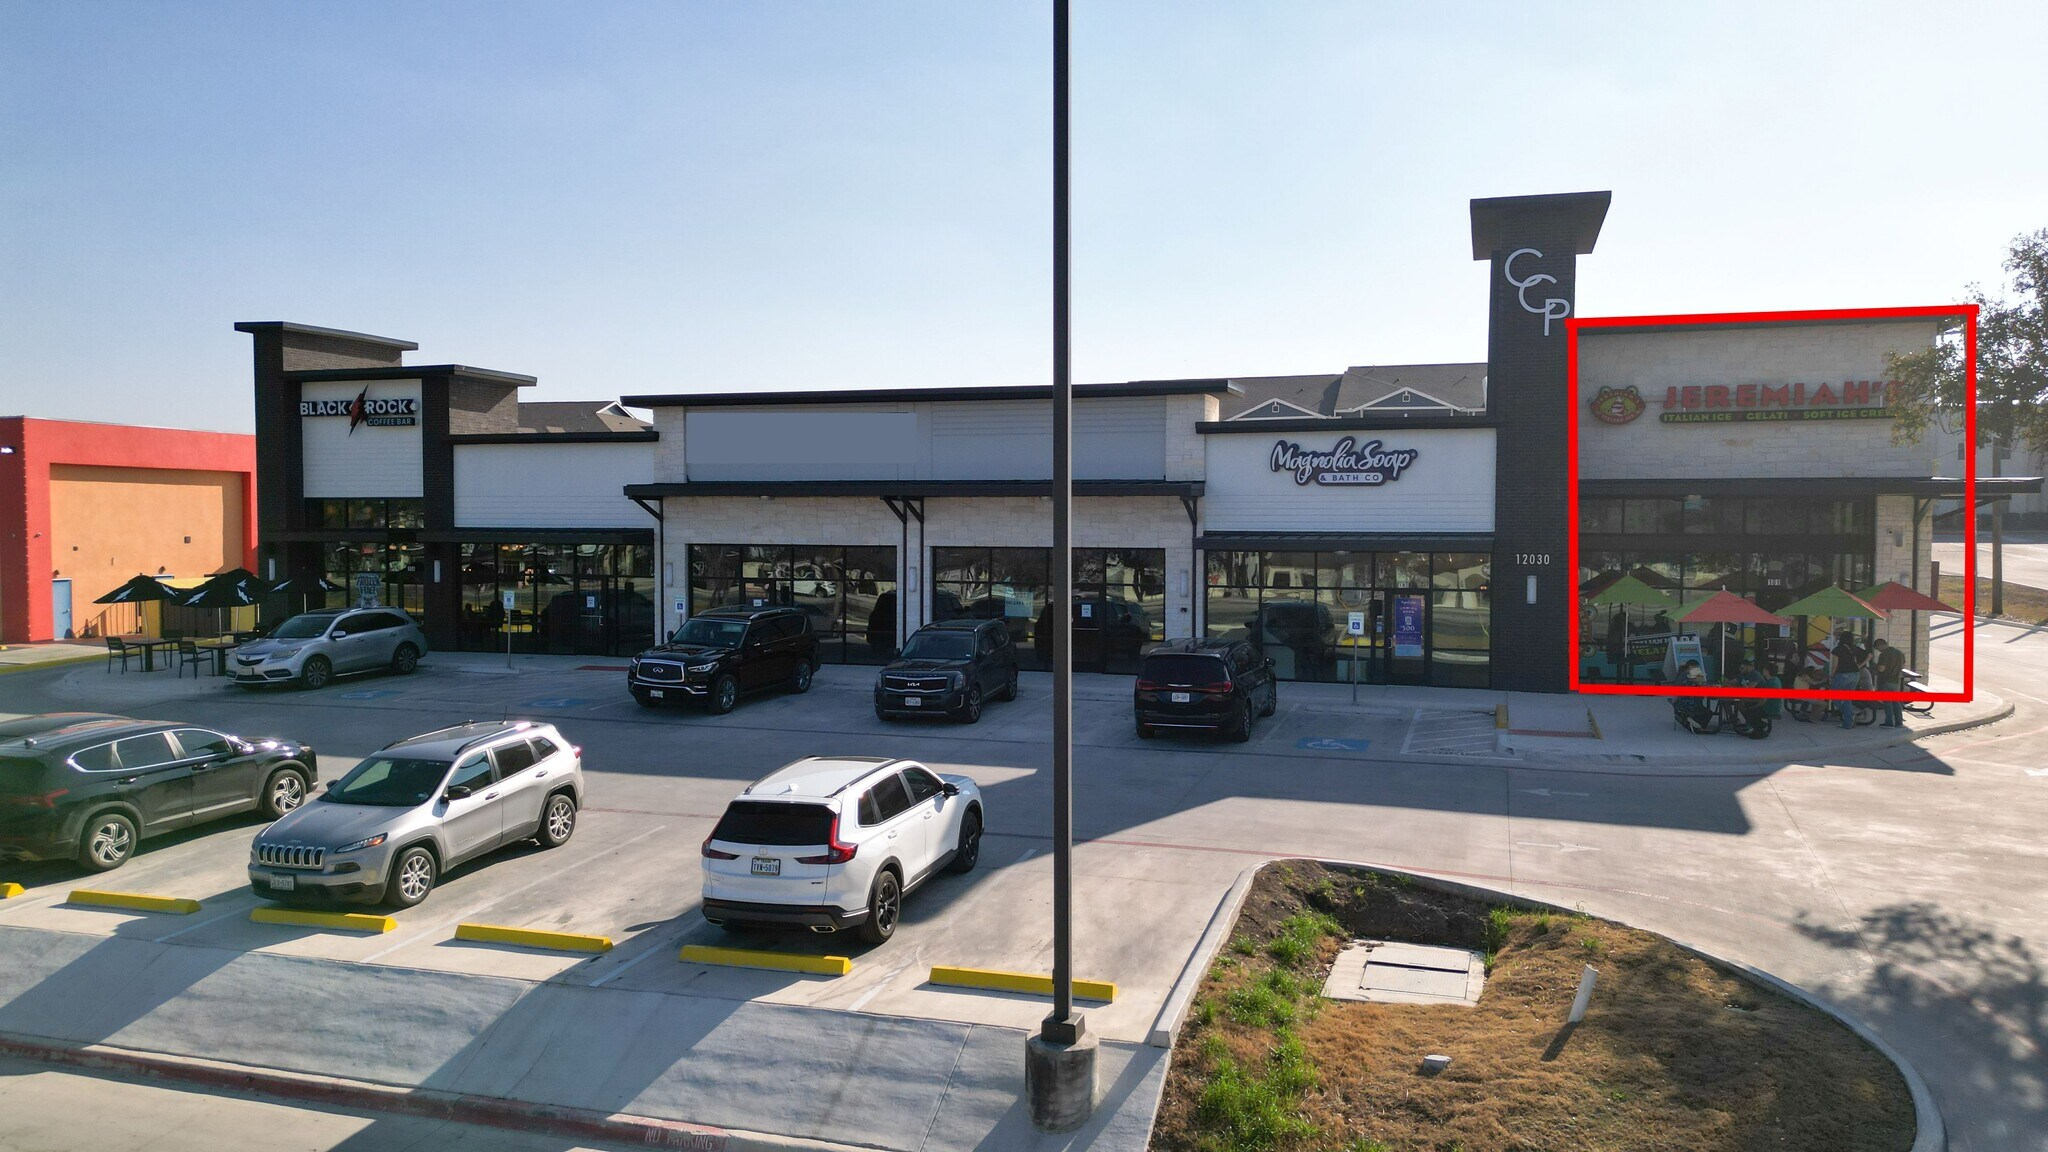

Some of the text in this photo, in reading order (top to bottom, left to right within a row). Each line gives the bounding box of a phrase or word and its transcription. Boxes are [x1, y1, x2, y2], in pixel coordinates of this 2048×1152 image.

[300, 401, 408, 415] BLACK ROCK
[1664, 413, 1709, 421] ITALIAN
[1746, 412, 1788, 420] GELATI
[1803, 411, 1833, 419] SOFT
[1271, 440, 1410, 483] Magnolia Soap
[1516, 554, 1550, 565] 12030
